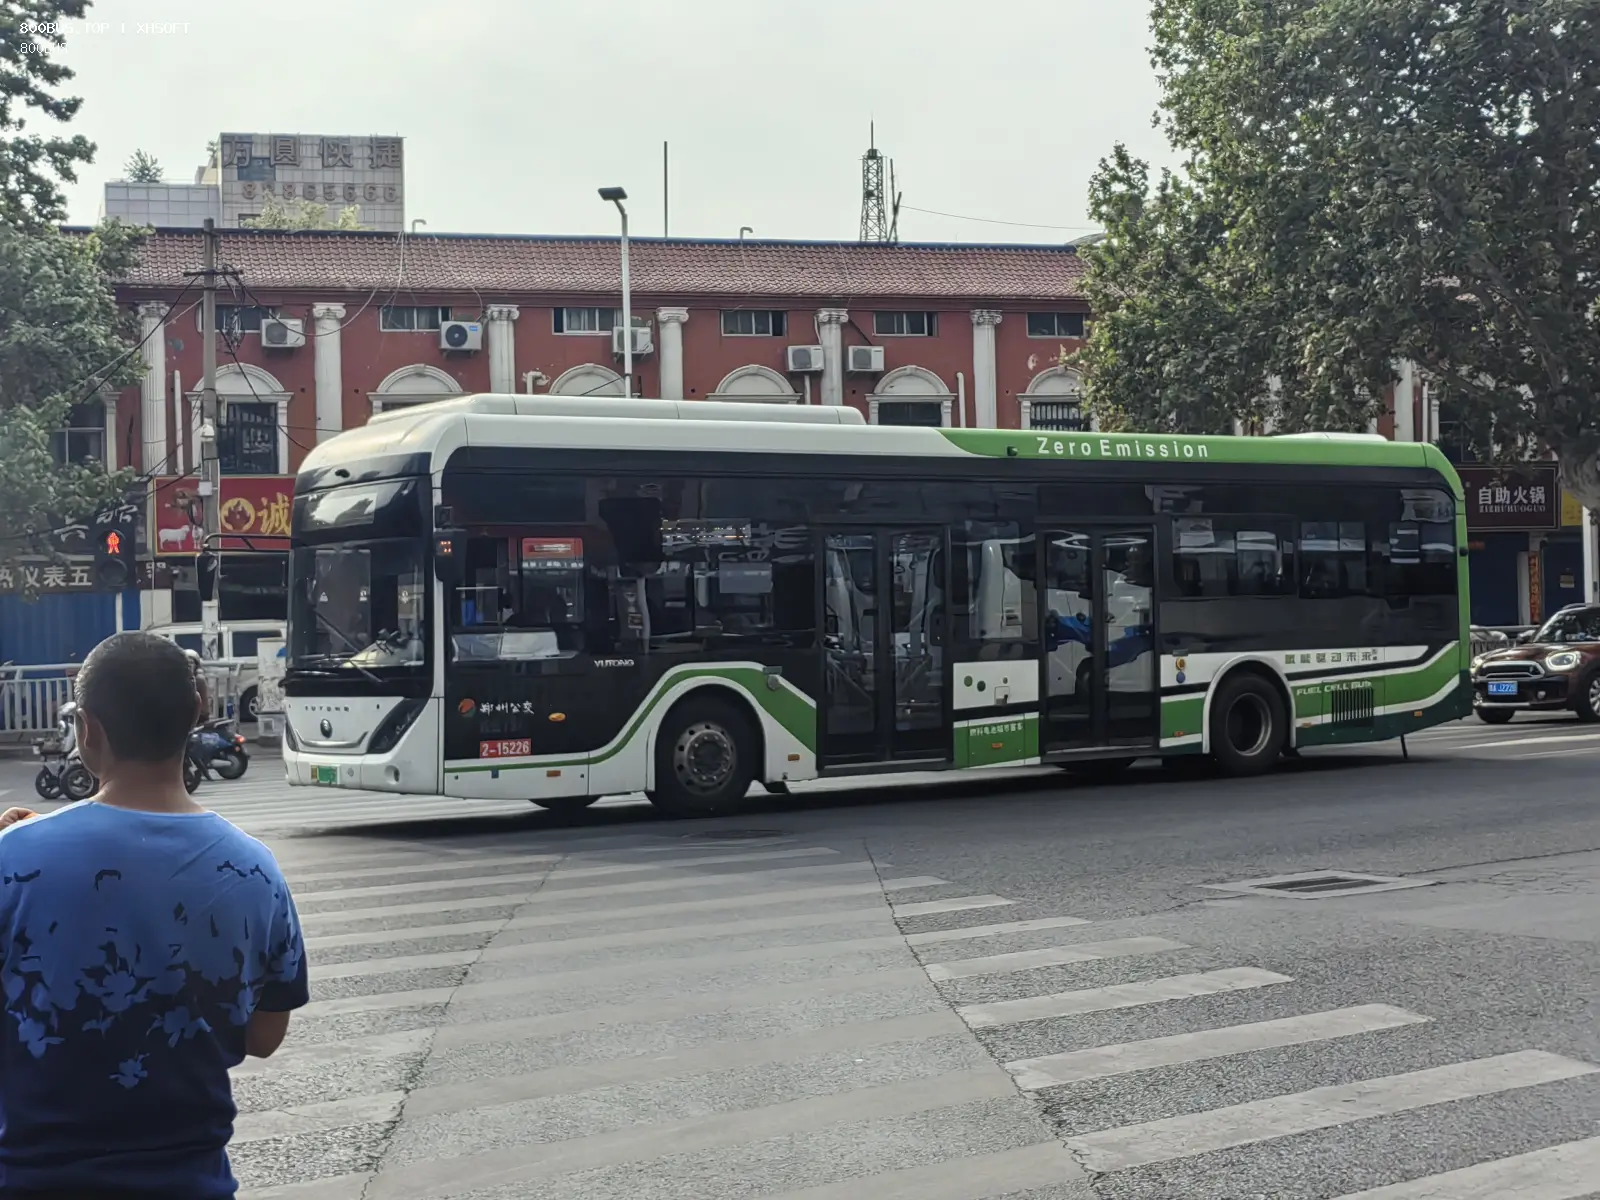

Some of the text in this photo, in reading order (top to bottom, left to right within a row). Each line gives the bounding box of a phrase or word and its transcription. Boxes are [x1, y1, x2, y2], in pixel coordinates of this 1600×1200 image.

[1036, 436, 1208, 458] Zero Emission
[1478, 486, 1546, 505] 自助火锅
[594, 659, 635, 668] YUTONG
[1296, 686, 1322, 696] FUEL
[1324, 682, 1349, 693] CELL
[479, 700, 535, 716] 郑州公交
[481, 740, 530, 757] 2-15226
